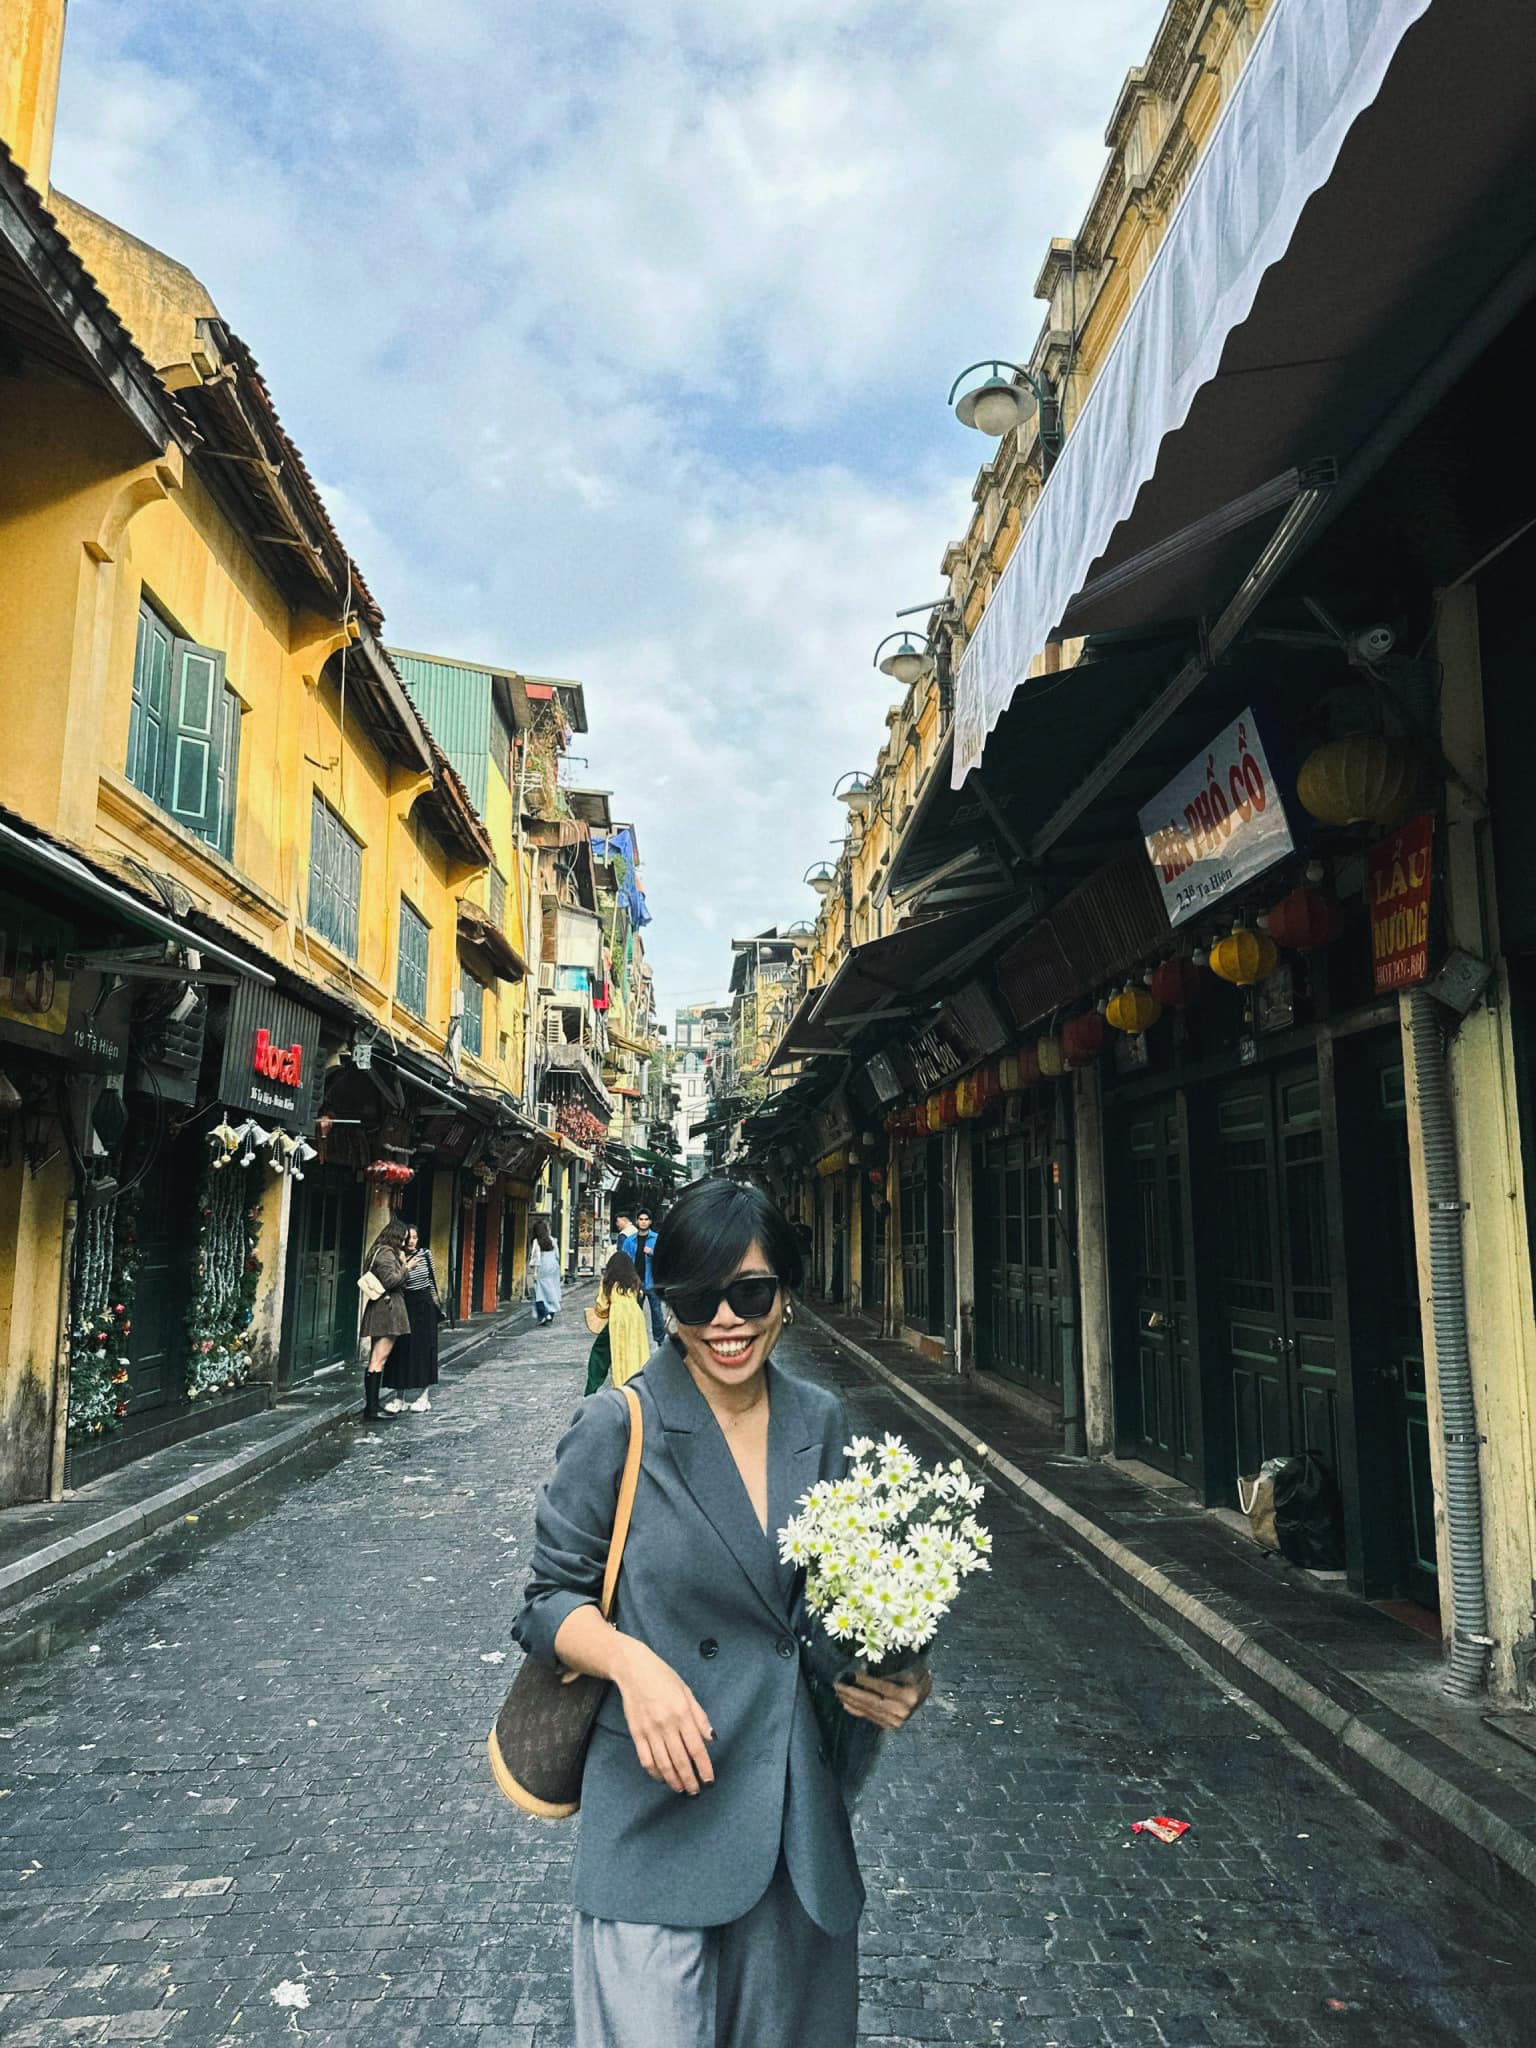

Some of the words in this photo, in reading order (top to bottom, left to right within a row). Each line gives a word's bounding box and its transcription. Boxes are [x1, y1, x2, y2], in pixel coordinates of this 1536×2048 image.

[1184, 753, 1233, 859] PHỐ
[1229, 722, 1265, 822] CỔ
[1375, 837, 1430, 905] LẨU
[1375, 901, 1428, 958] NƯỚNG
[73, 1030, 85, 1048] 18
